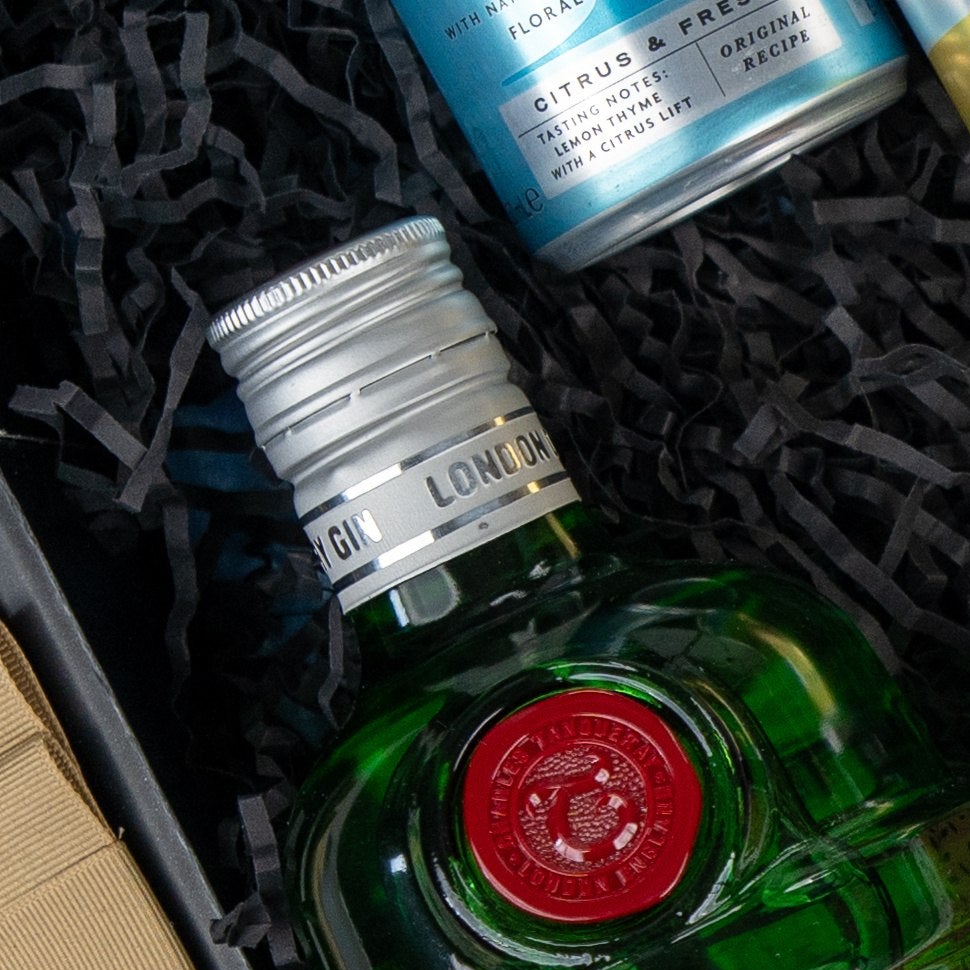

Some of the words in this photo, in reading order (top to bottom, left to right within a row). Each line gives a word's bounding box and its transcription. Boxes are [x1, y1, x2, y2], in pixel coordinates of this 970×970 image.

[444, 12, 481, 40] WITH
[720, 6, 811, 59] ORIGINAL
[742, 29, 811, 72] RECIPE
[534, 52, 632, 113] CITRUS
[648, 36, 666, 51] &
[536, 104, 600, 145] TASTING
[605, 70, 669, 108] NOTES:
[551, 156, 584, 181] WITH
[588, 151, 597, 162] A
[601, 119, 655, 153] CITRUS
[659, 96, 692, 122] LIFT
[554, 124, 603, 157] LEMON
[607, 92, 662, 127] THYME
[328, 509, 383, 561] GIN
[426, 429, 550, 508] LONDON
